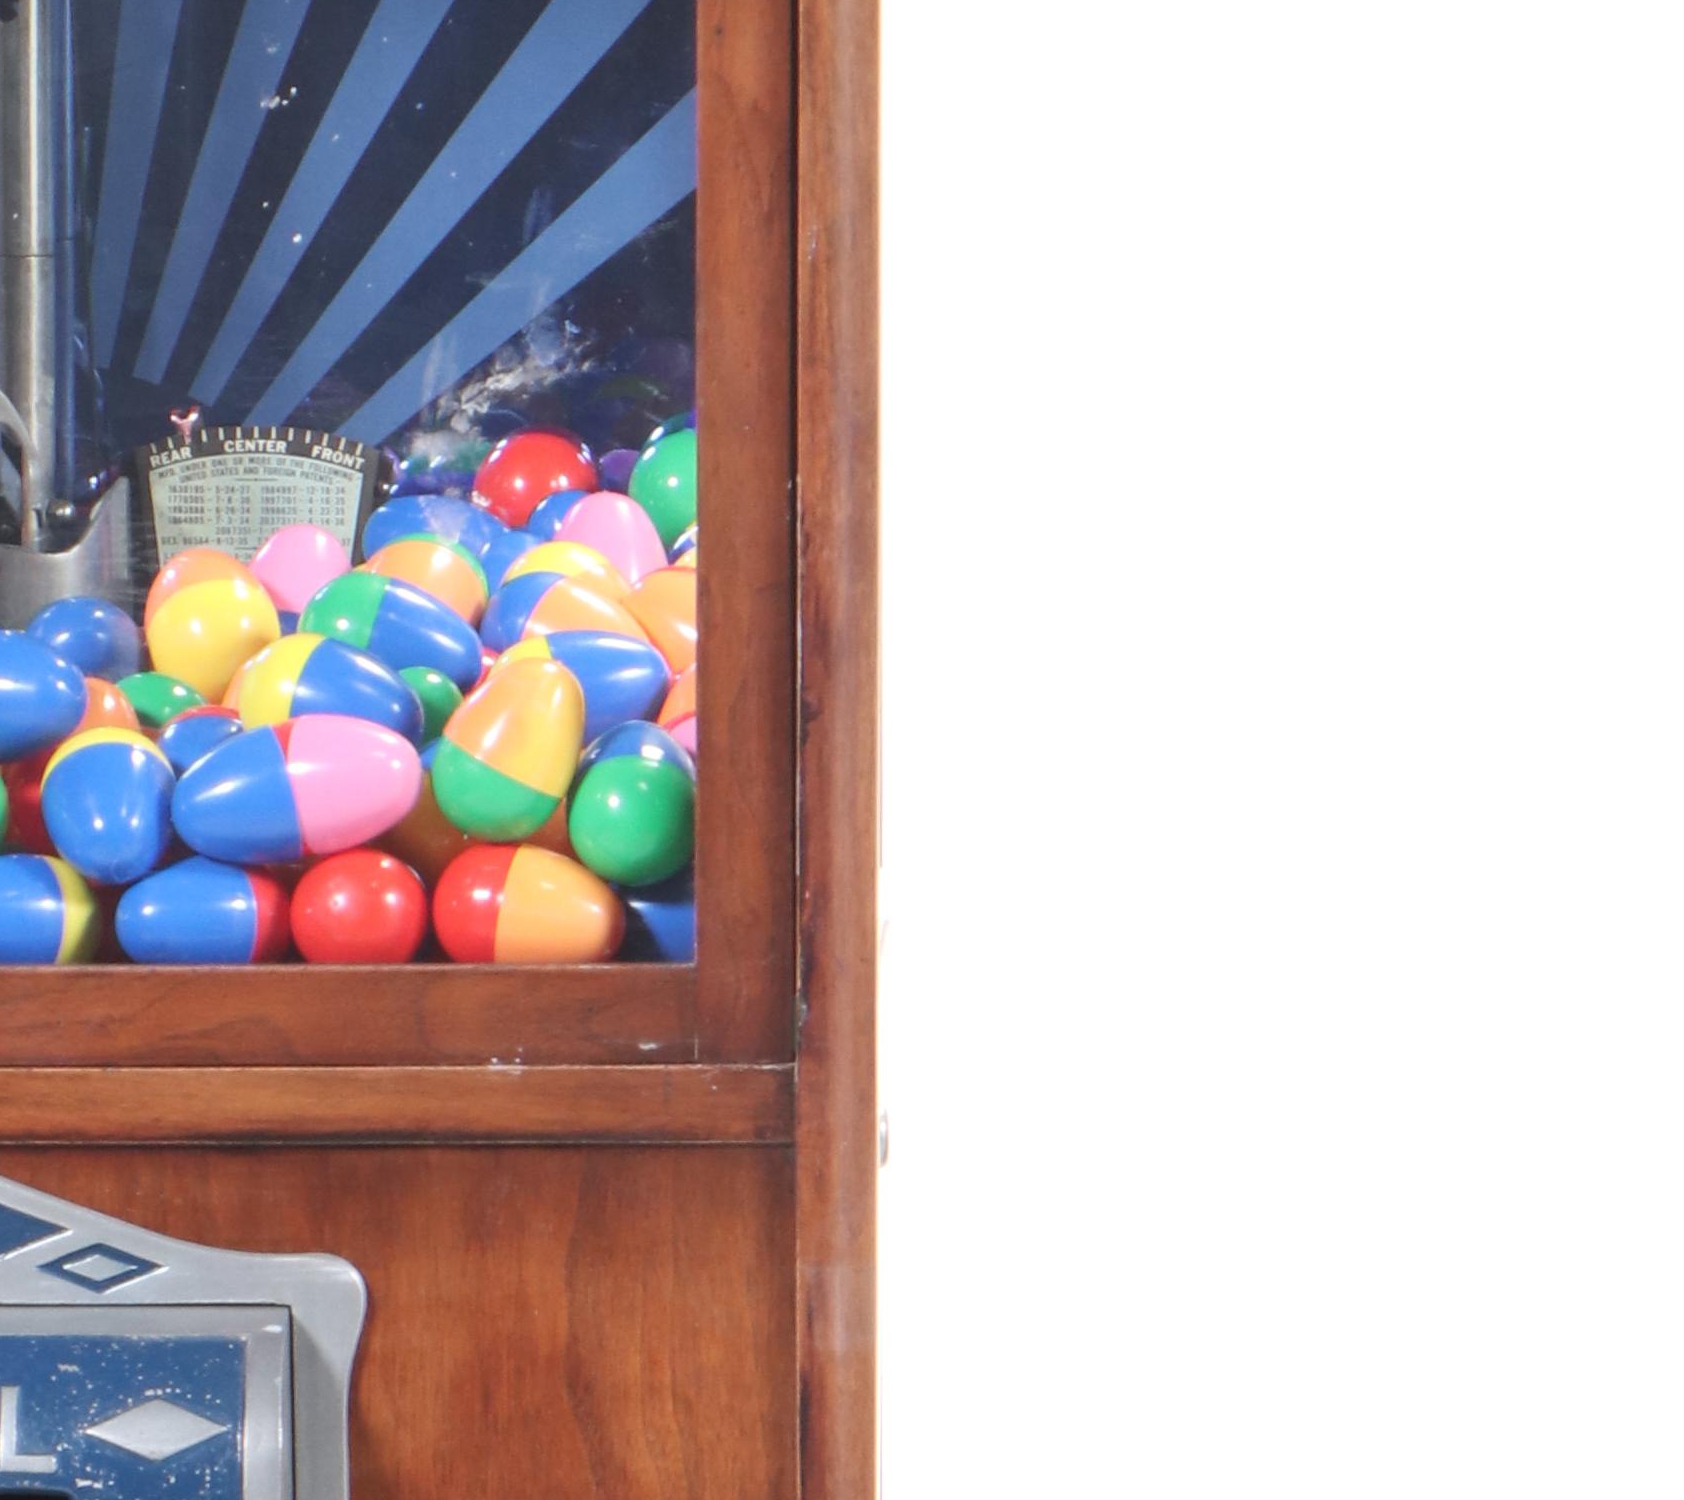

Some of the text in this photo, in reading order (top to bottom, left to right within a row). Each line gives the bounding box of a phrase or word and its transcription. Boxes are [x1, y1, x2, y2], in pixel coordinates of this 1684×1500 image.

[149, 439, 365, 470] REAR CENTER FRONT
[180, 460, 207, 474] UNDER
[211, 457, 228, 468] ONE
[232, 456, 243, 466] OR
[248, 456, 272, 467] MORE
[276, 457, 287, 467] OF
[290, 458, 305, 469] THE
[309, 461, 354, 482] FOLLOWING
[180, 471, 207, 484] UNITED
[211, 467, 239, 478] STATES
[243, 466, 260, 475] AND
[263, 466, 296, 478] FOREIGN
